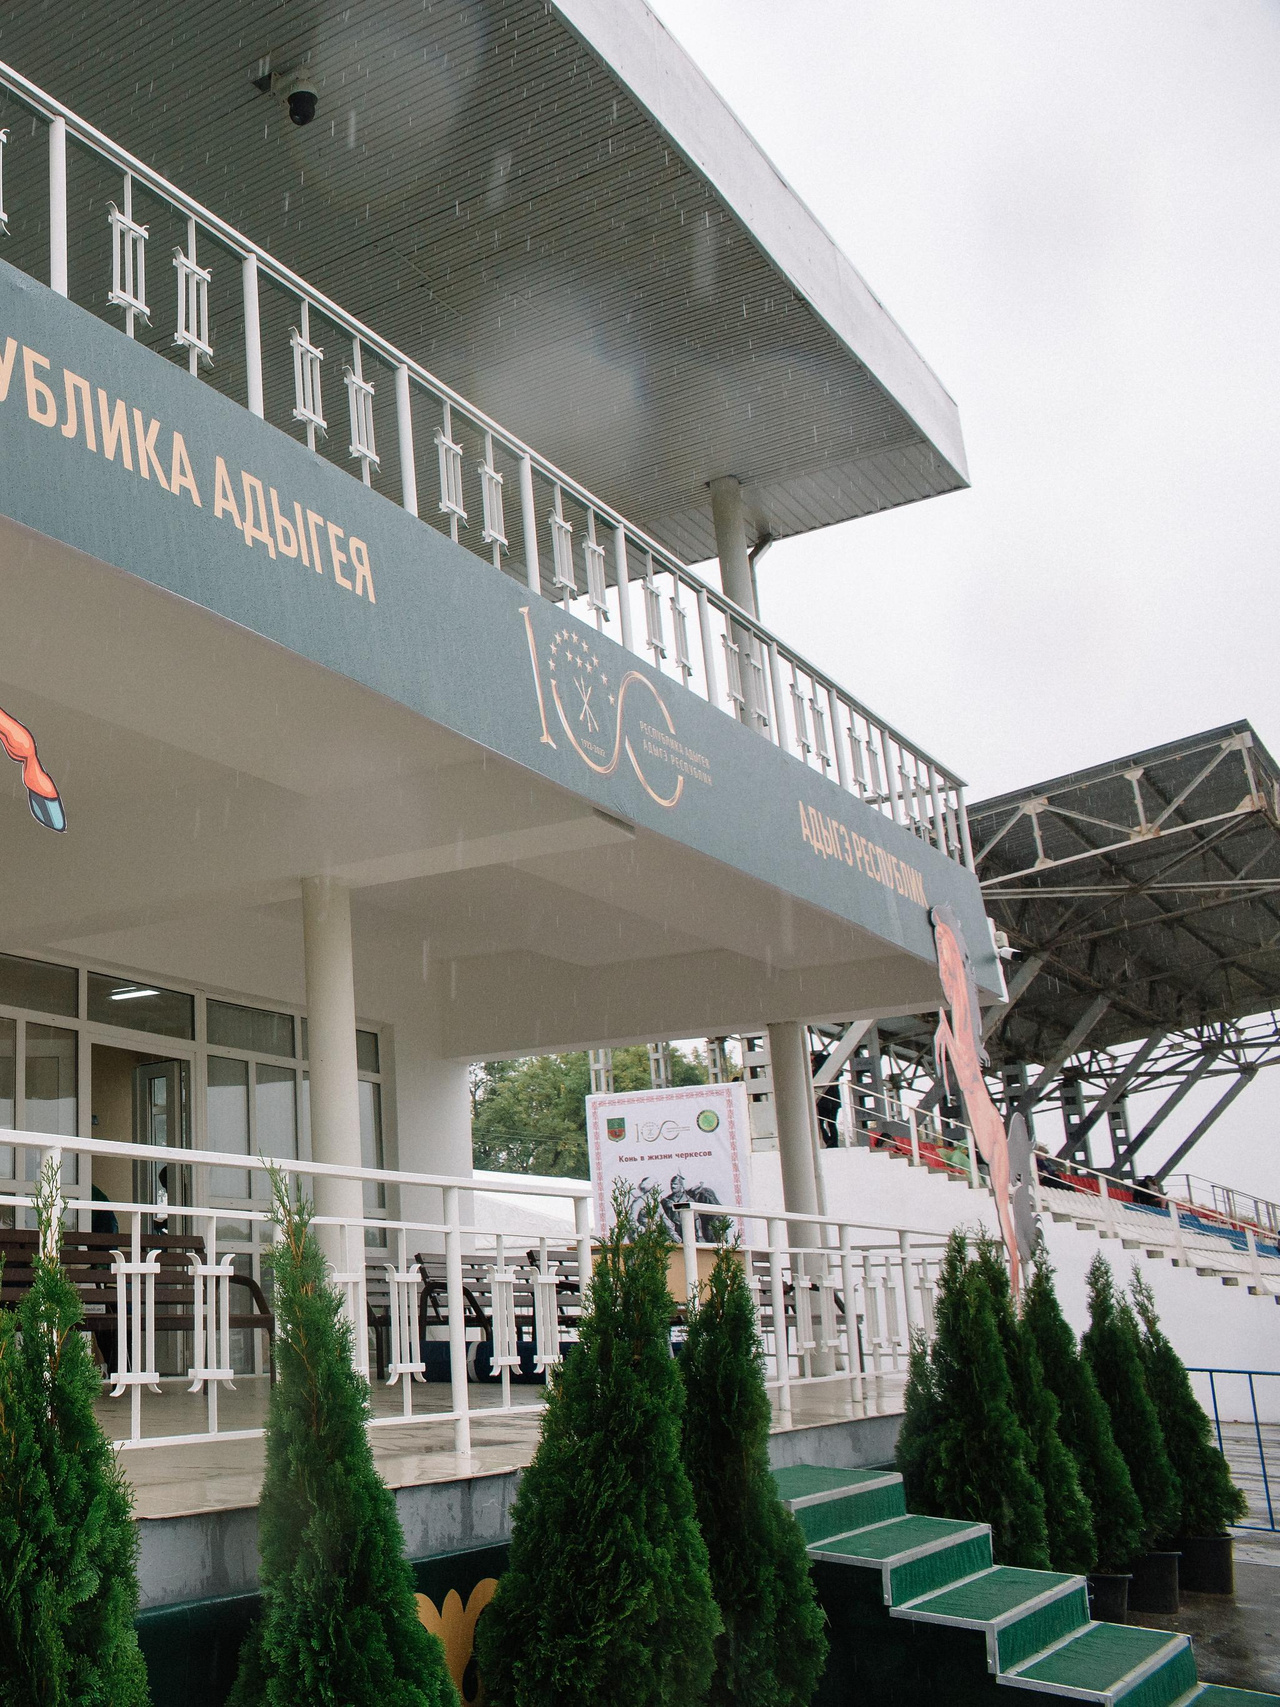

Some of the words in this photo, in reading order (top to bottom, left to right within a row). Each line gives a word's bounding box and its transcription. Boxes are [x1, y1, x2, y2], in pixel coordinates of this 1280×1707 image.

[213, 455, 376, 604] АДЫГЕЯ
[799, 800, 854, 867] АДЫГЭ
[851, 831, 930, 910] РЕСПУБЛИК
[618, 1155, 638, 1163] Конь
[647, 1153, 673, 1161] жизни
[675, 1150, 713, 1160] черкесов
